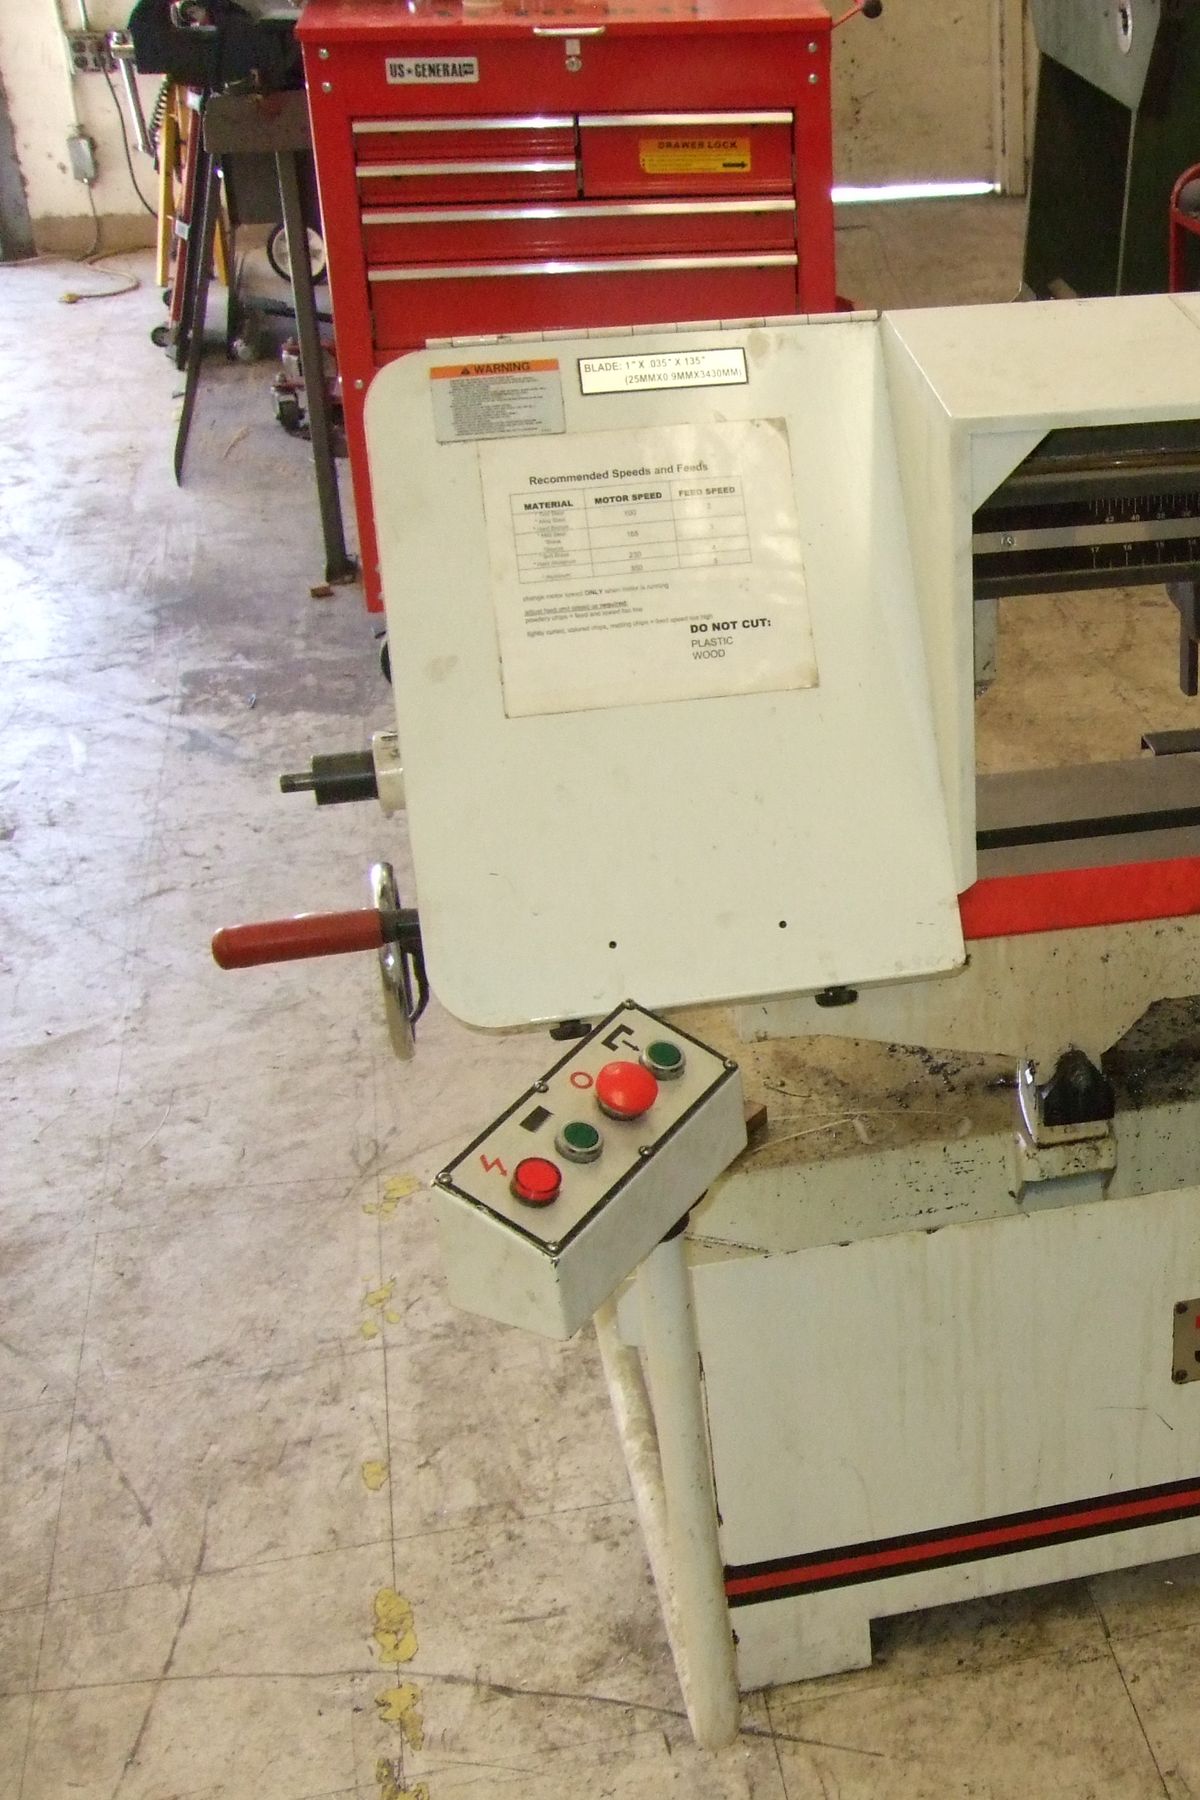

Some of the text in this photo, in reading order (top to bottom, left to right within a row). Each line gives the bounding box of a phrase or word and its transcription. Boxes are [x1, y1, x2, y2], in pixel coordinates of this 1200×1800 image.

[389, 63, 405, 78] US
[657, 141, 737, 150] DRAWER LOCK
[474, 361, 530, 375] WARNING
[584, 362, 622, 373] BLADE:
[639, 361, 645, 369] X
[675, 357, 681, 366] X
[529, 463, 708, 486] Recommended Speeds and Feeds
[594, 491, 662, 505] MOTOR SPEED
[679, 486, 736, 498] FEED SPEED
[524, 499, 573, 511] MATERIAL
[690, 617, 772, 634] DO NOT CUT:
[691, 635, 734, 649] PLASTIC
[692, 648, 726, 661] WOOD
